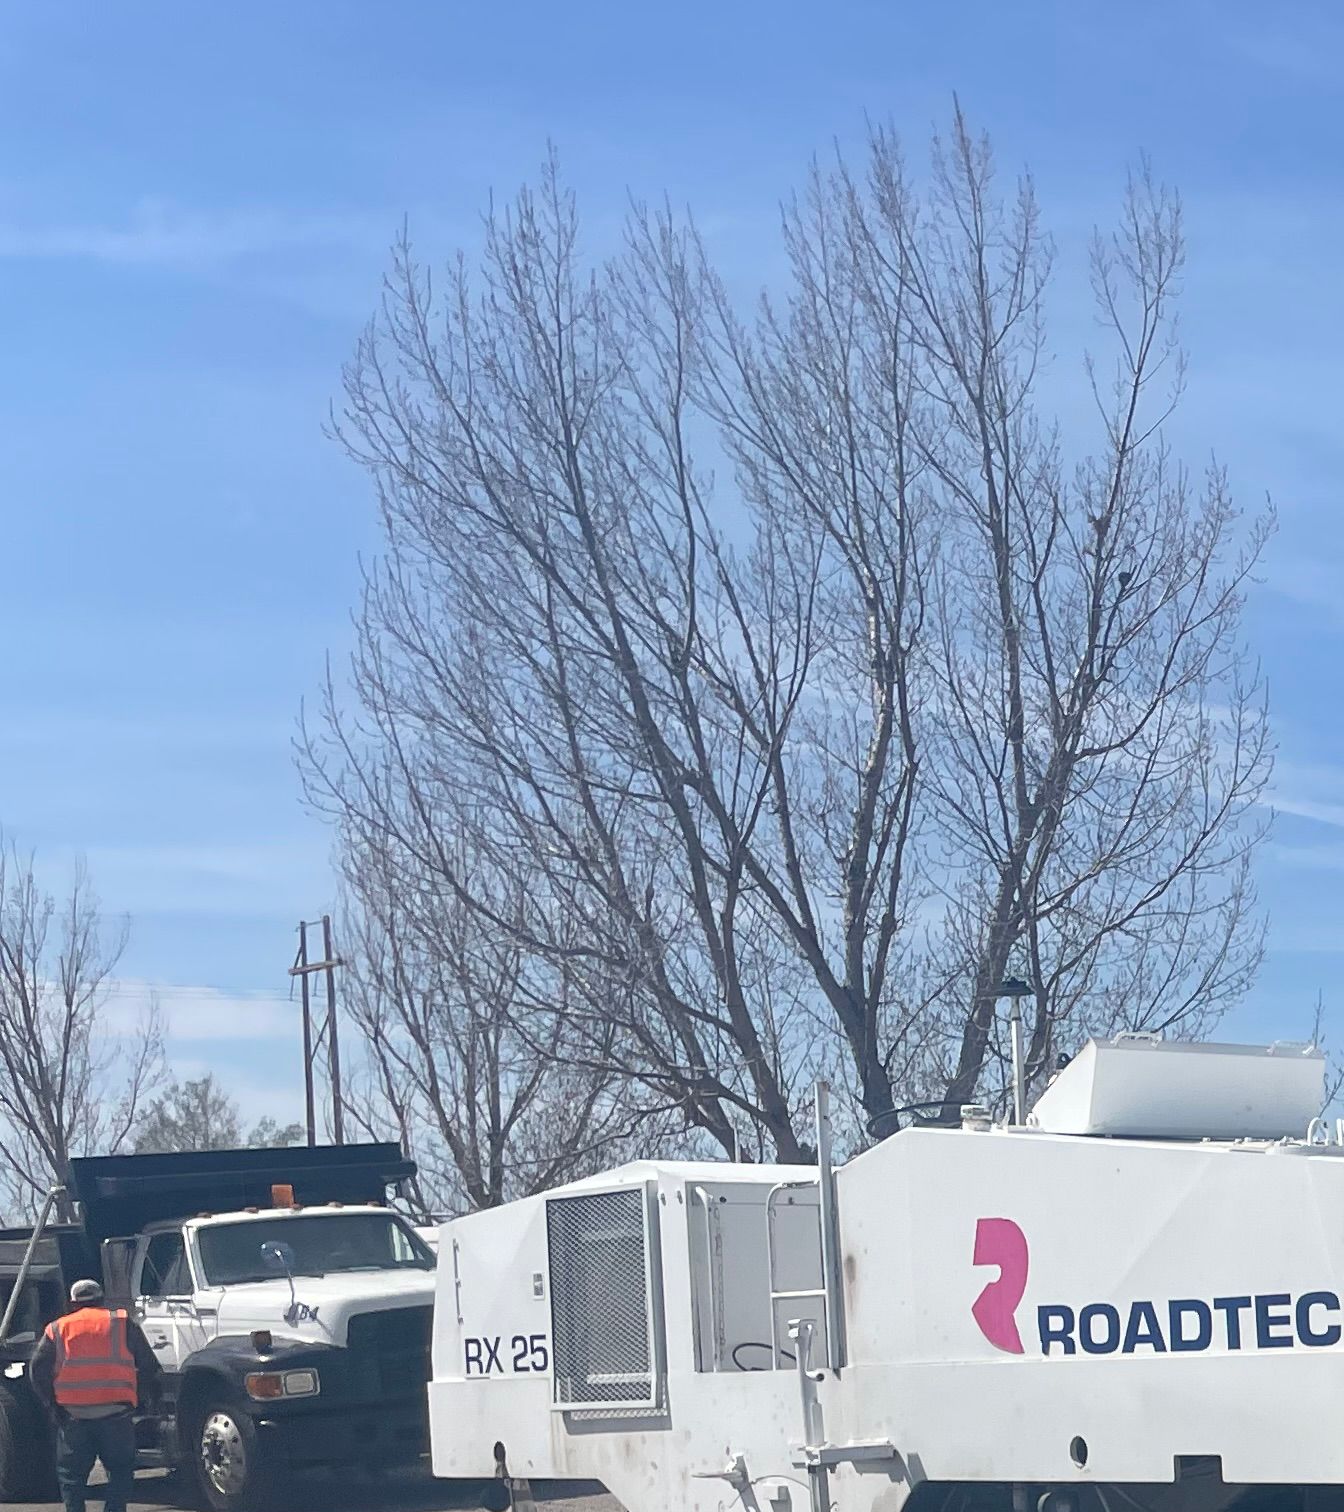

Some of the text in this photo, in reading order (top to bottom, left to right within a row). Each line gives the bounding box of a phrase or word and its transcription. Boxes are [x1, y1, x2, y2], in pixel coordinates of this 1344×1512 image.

[1037, 1291, 1342, 1355] ROADTEC
[465, 1334, 548, 1374] RX 25
